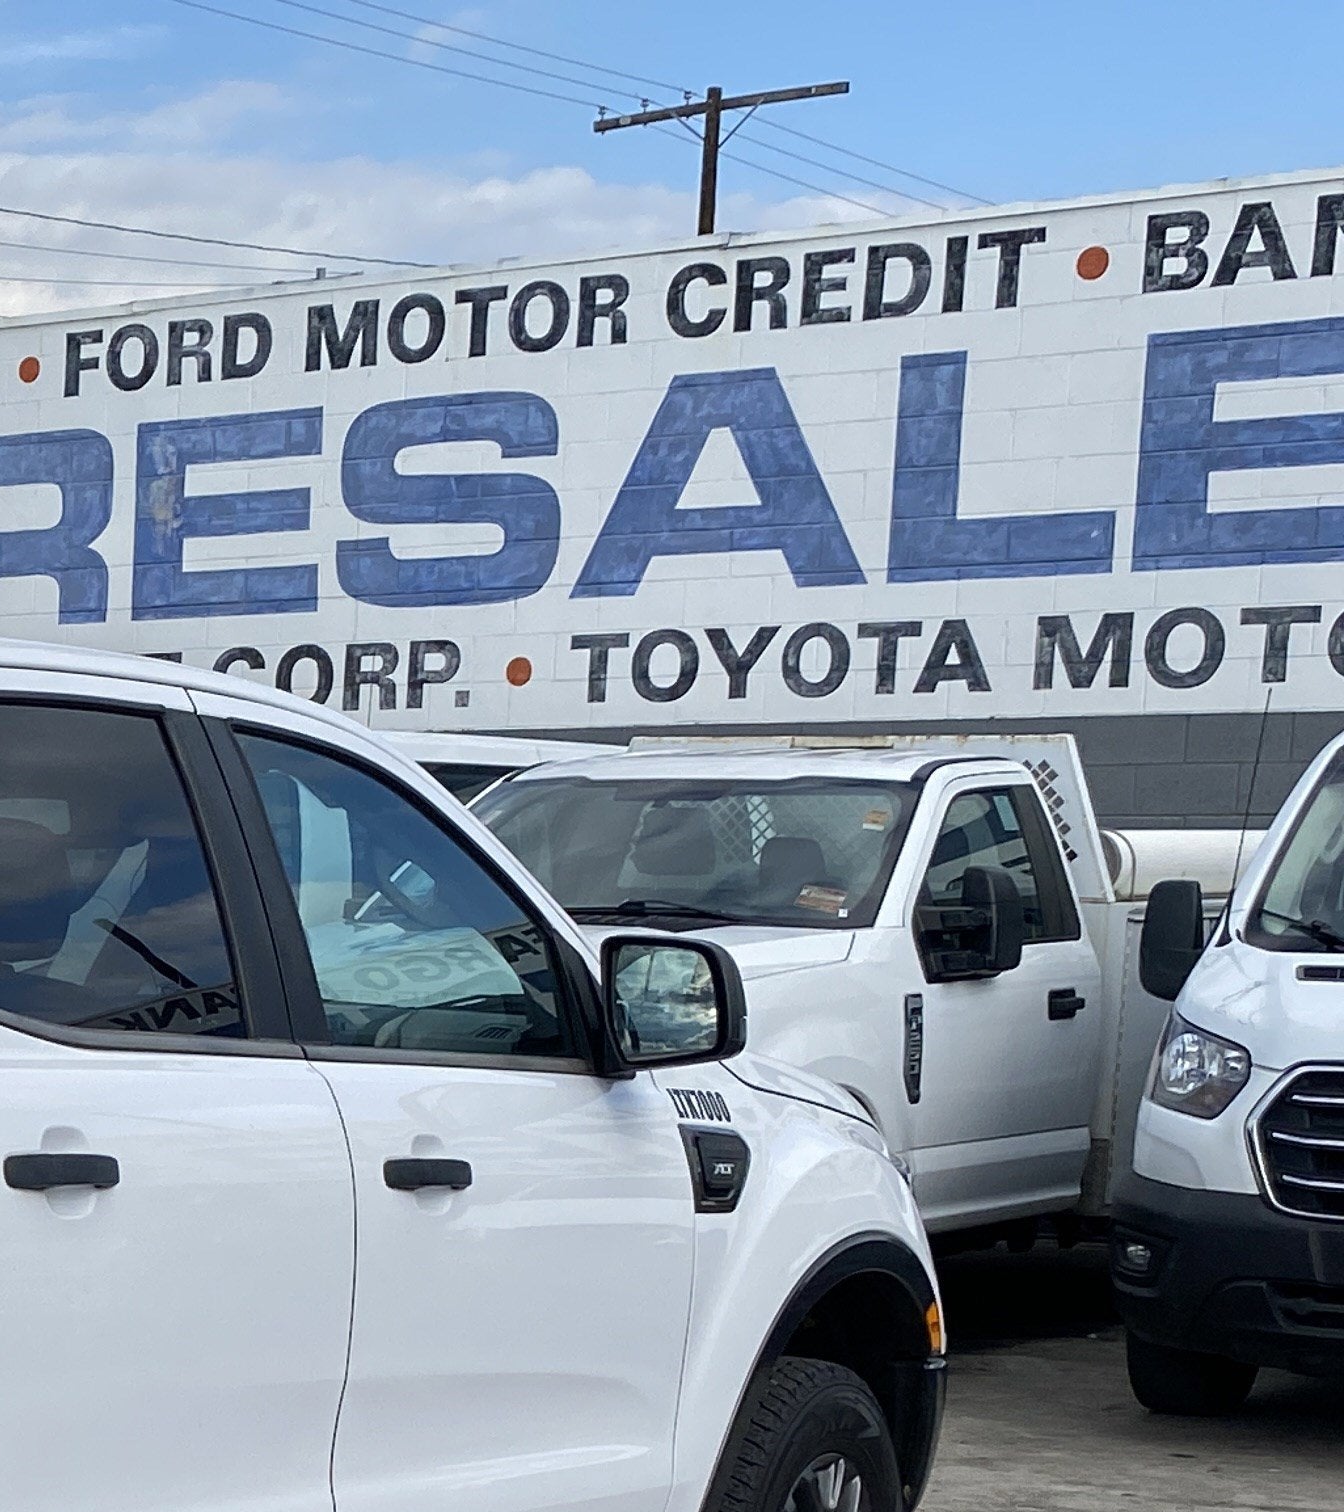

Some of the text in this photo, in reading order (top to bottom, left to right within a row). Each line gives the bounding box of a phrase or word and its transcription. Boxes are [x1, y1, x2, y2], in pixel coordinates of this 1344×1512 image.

[62, 312, 273, 398] FORD
[304, 272, 630, 373] MOTOR
[665, 227, 1047, 339] CREDIT
[570, 618, 992, 704] TOYOTA
[1032, 605, 1344, 691] MOT
